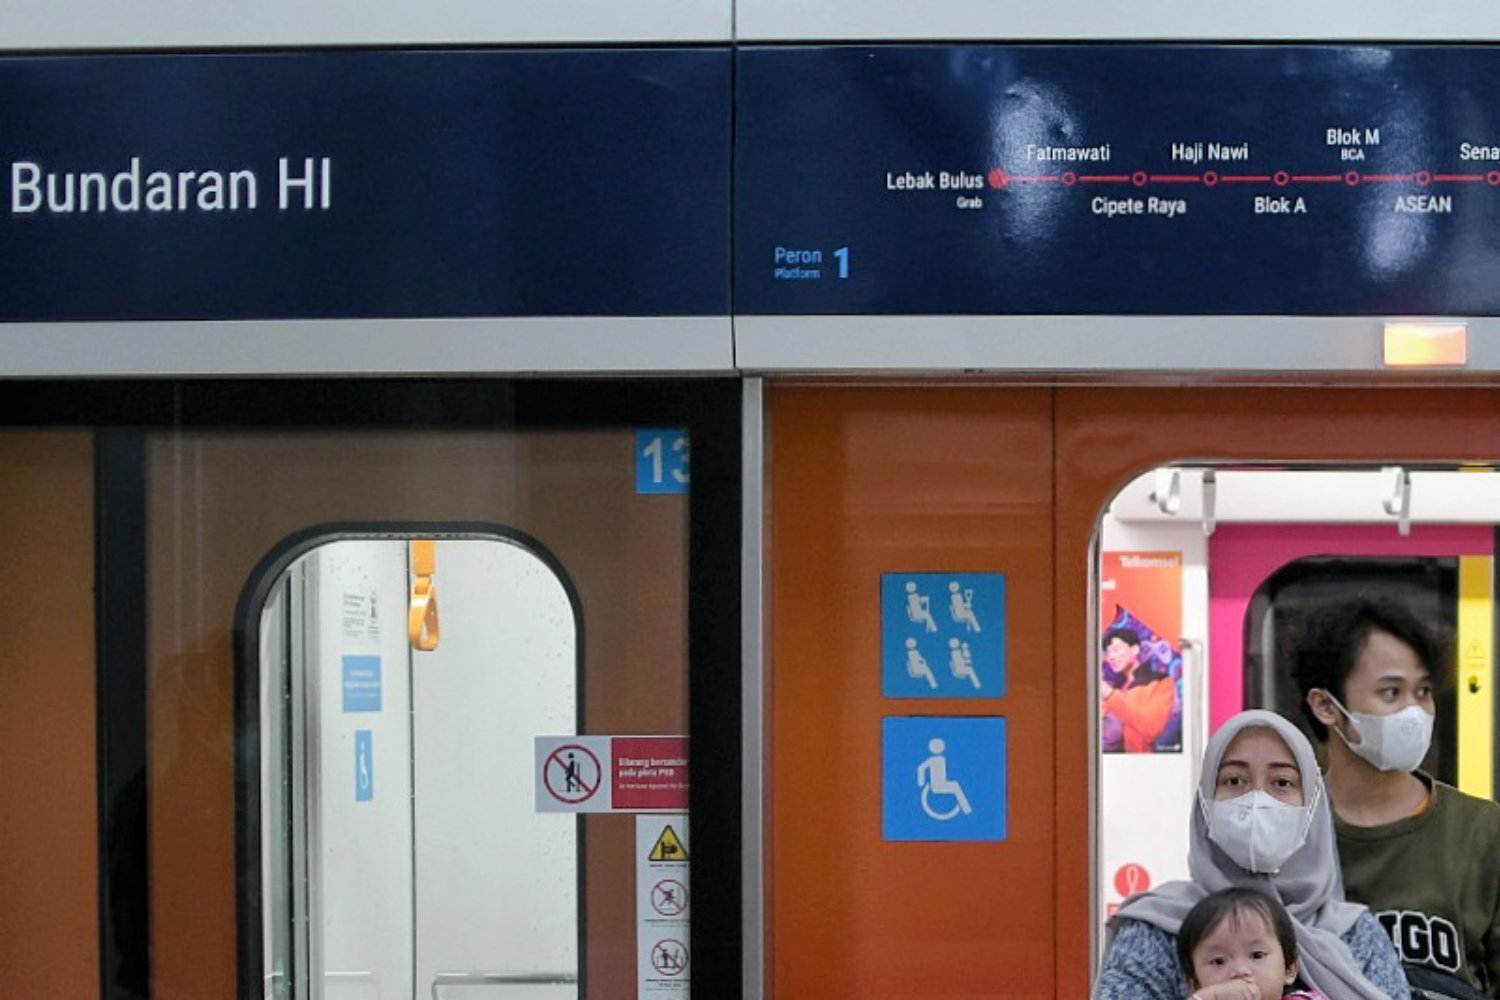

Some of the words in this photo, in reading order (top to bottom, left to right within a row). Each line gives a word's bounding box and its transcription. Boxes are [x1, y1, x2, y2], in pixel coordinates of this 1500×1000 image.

[1327, 128, 1361, 145] Blok
[1365, 128, 1380, 145] M
[1027, 144, 1111, 161] Fatmawati
[1172, 143, 1202, 164] Haji
[1207, 143, 1249, 160] Nawi
[1341, 149, 1365, 160] BCA
[11, 157, 257, 213] Bundaran
[279, 157, 331, 210] HI
[886, 172, 935, 189] Lebak
[940, 172, 983, 190] Bulus
[1091, 196, 1143, 216] Cipete
[1148, 197, 1187, 216] Raya
[1254, 197, 1289, 214] Blok
[1293, 198, 1306, 214] A
[1395, 196, 1452, 213] ASEAN
[774, 246, 823, 263] Peron
[833, 246, 849, 279] 1
[643, 437, 691, 484] 13
